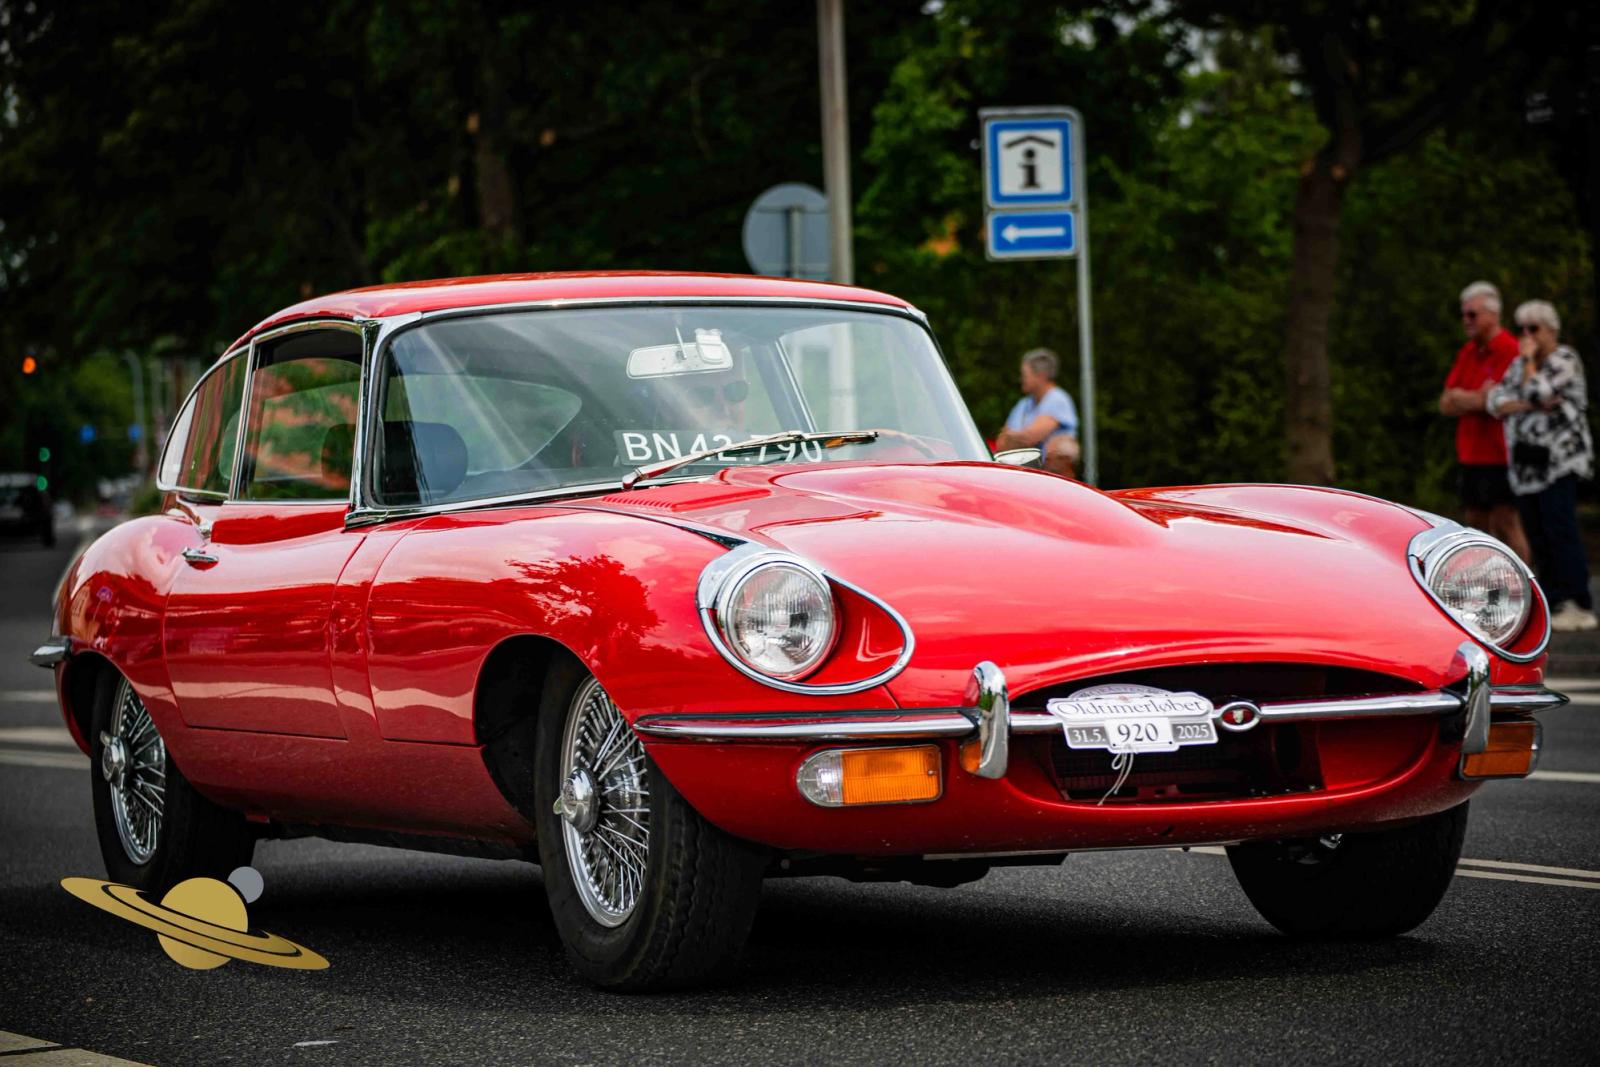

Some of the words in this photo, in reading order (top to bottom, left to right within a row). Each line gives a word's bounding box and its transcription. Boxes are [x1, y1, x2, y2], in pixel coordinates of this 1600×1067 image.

[622, 432, 682, 461] BN
[689, 433, 823, 463] 42.790
[1117, 722, 1159, 742] 920
[1175, 725, 1211, 740] 2025
